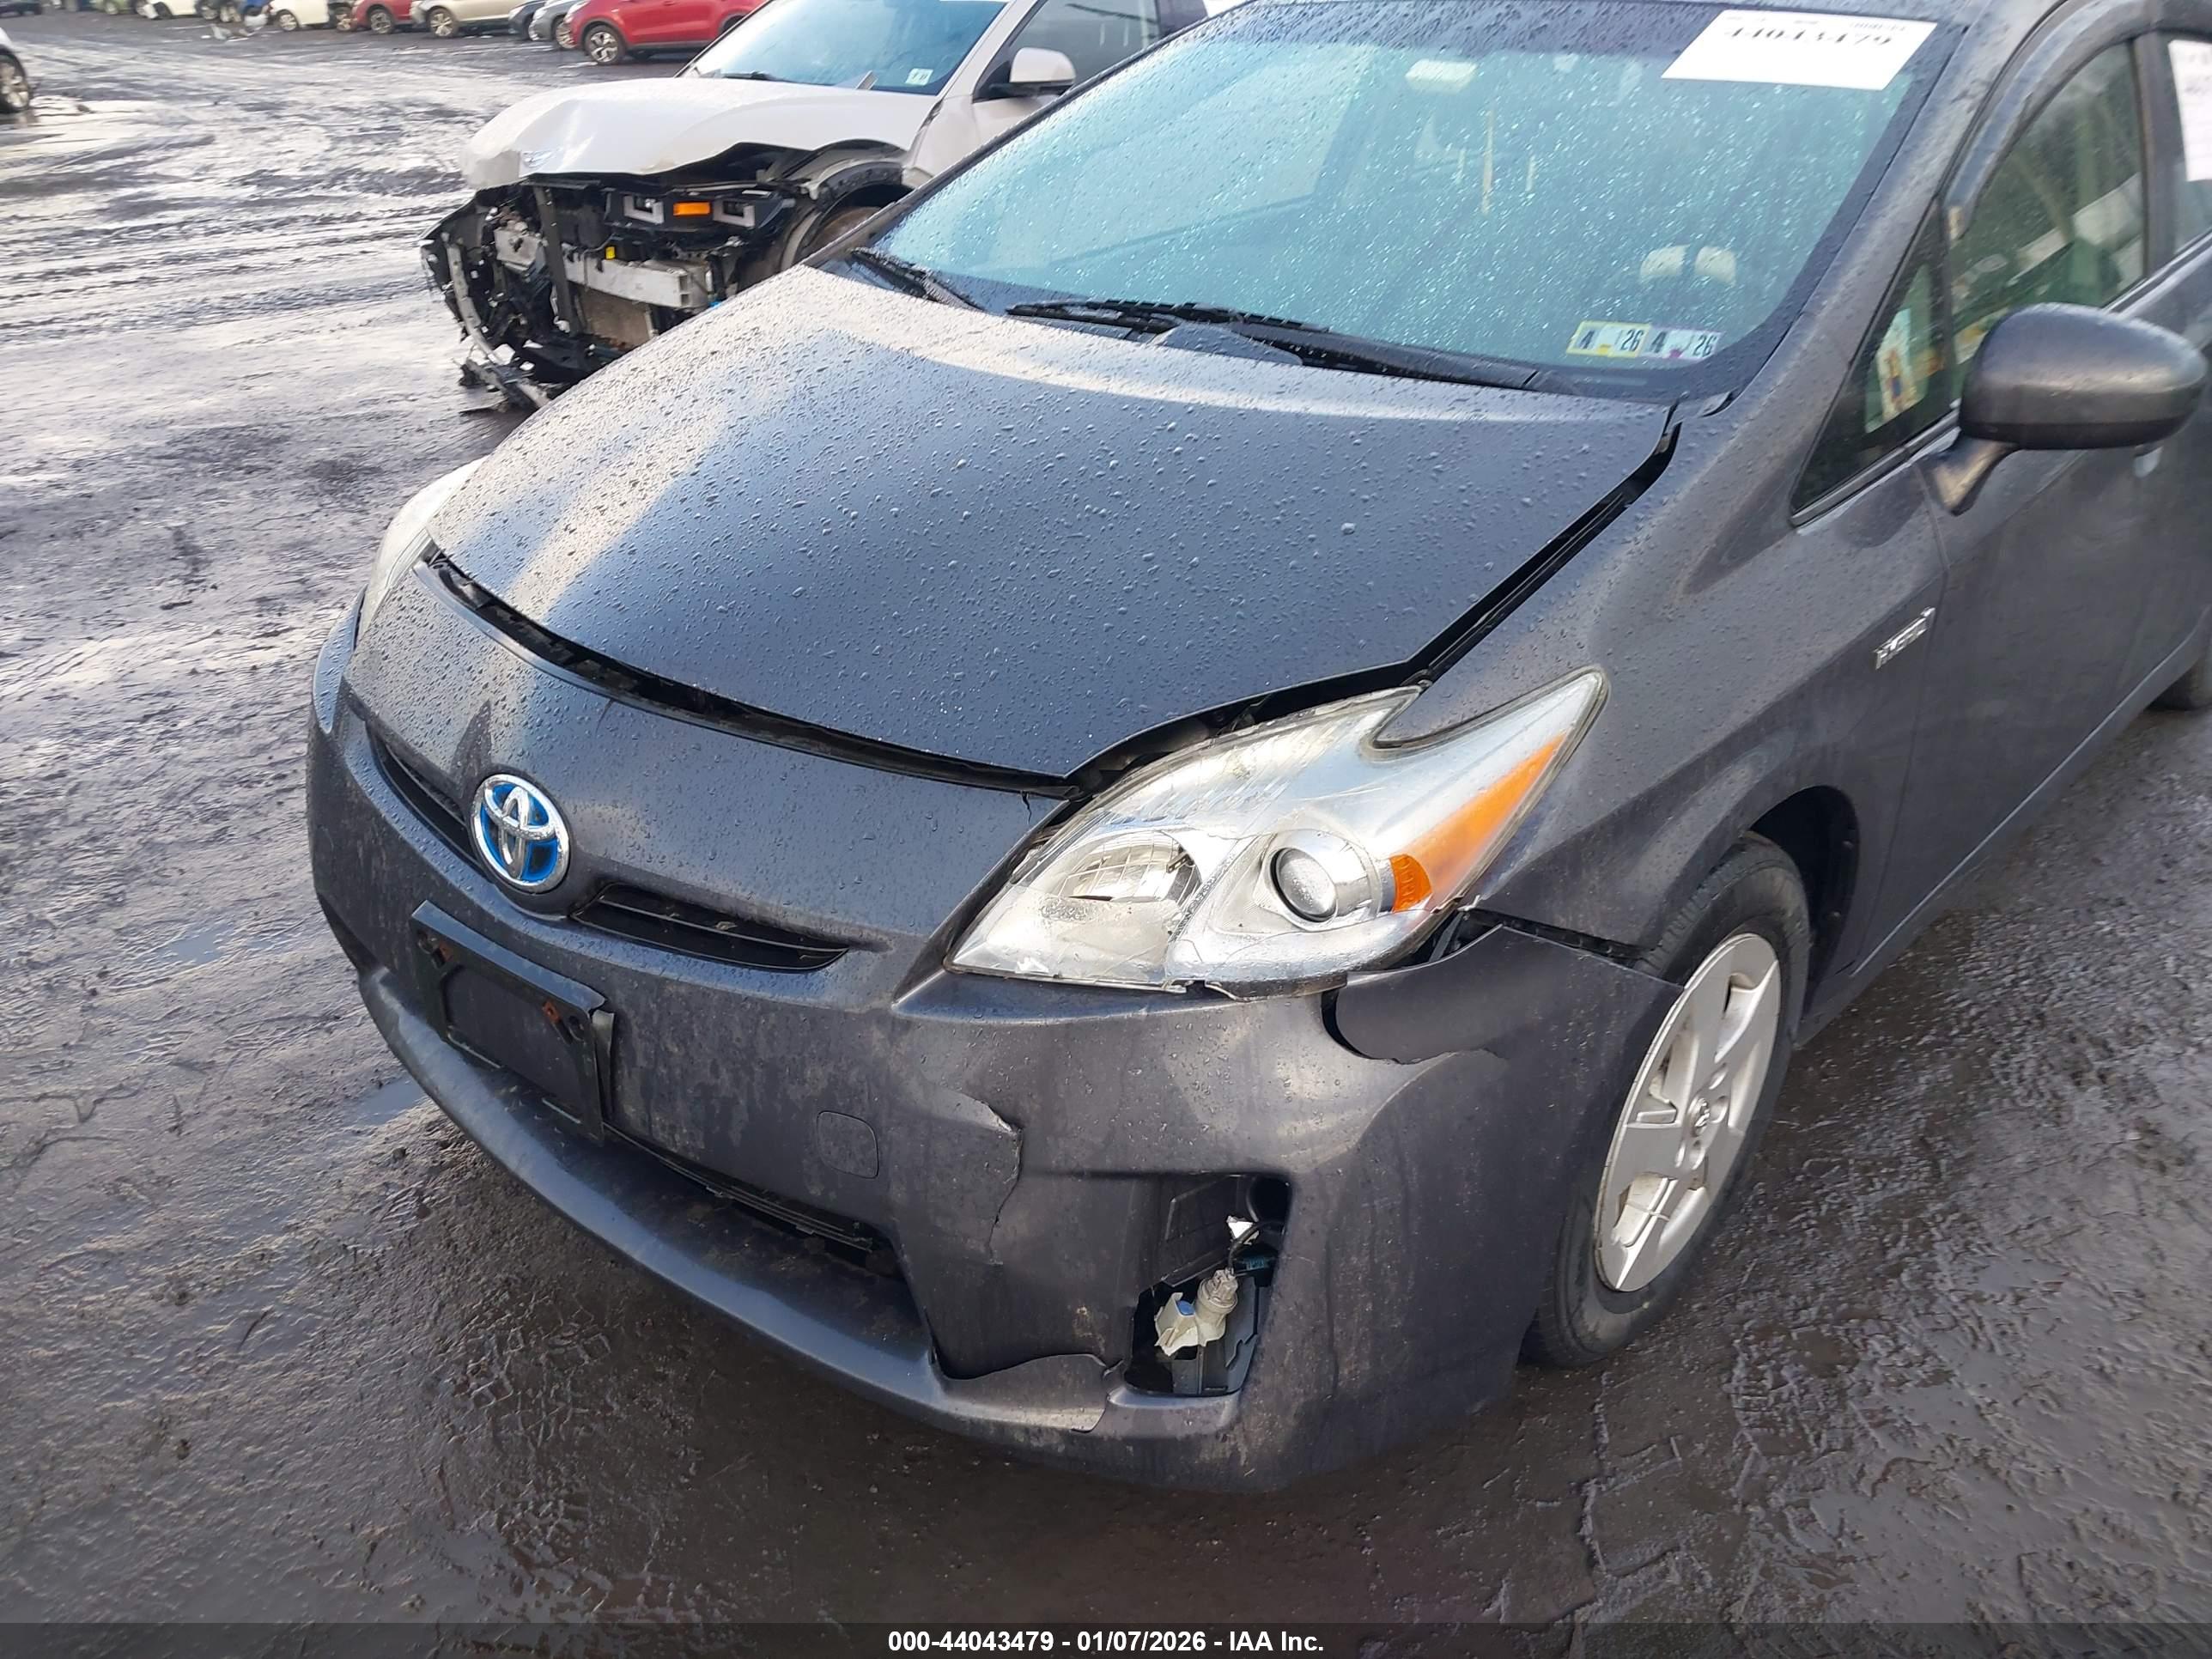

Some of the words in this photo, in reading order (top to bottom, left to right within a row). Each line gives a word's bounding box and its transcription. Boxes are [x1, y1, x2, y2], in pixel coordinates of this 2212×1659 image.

[1581, 330, 1595, 349] 4
[1620, 328, 1645, 352] 26
[1692, 334, 1717, 356] 26
